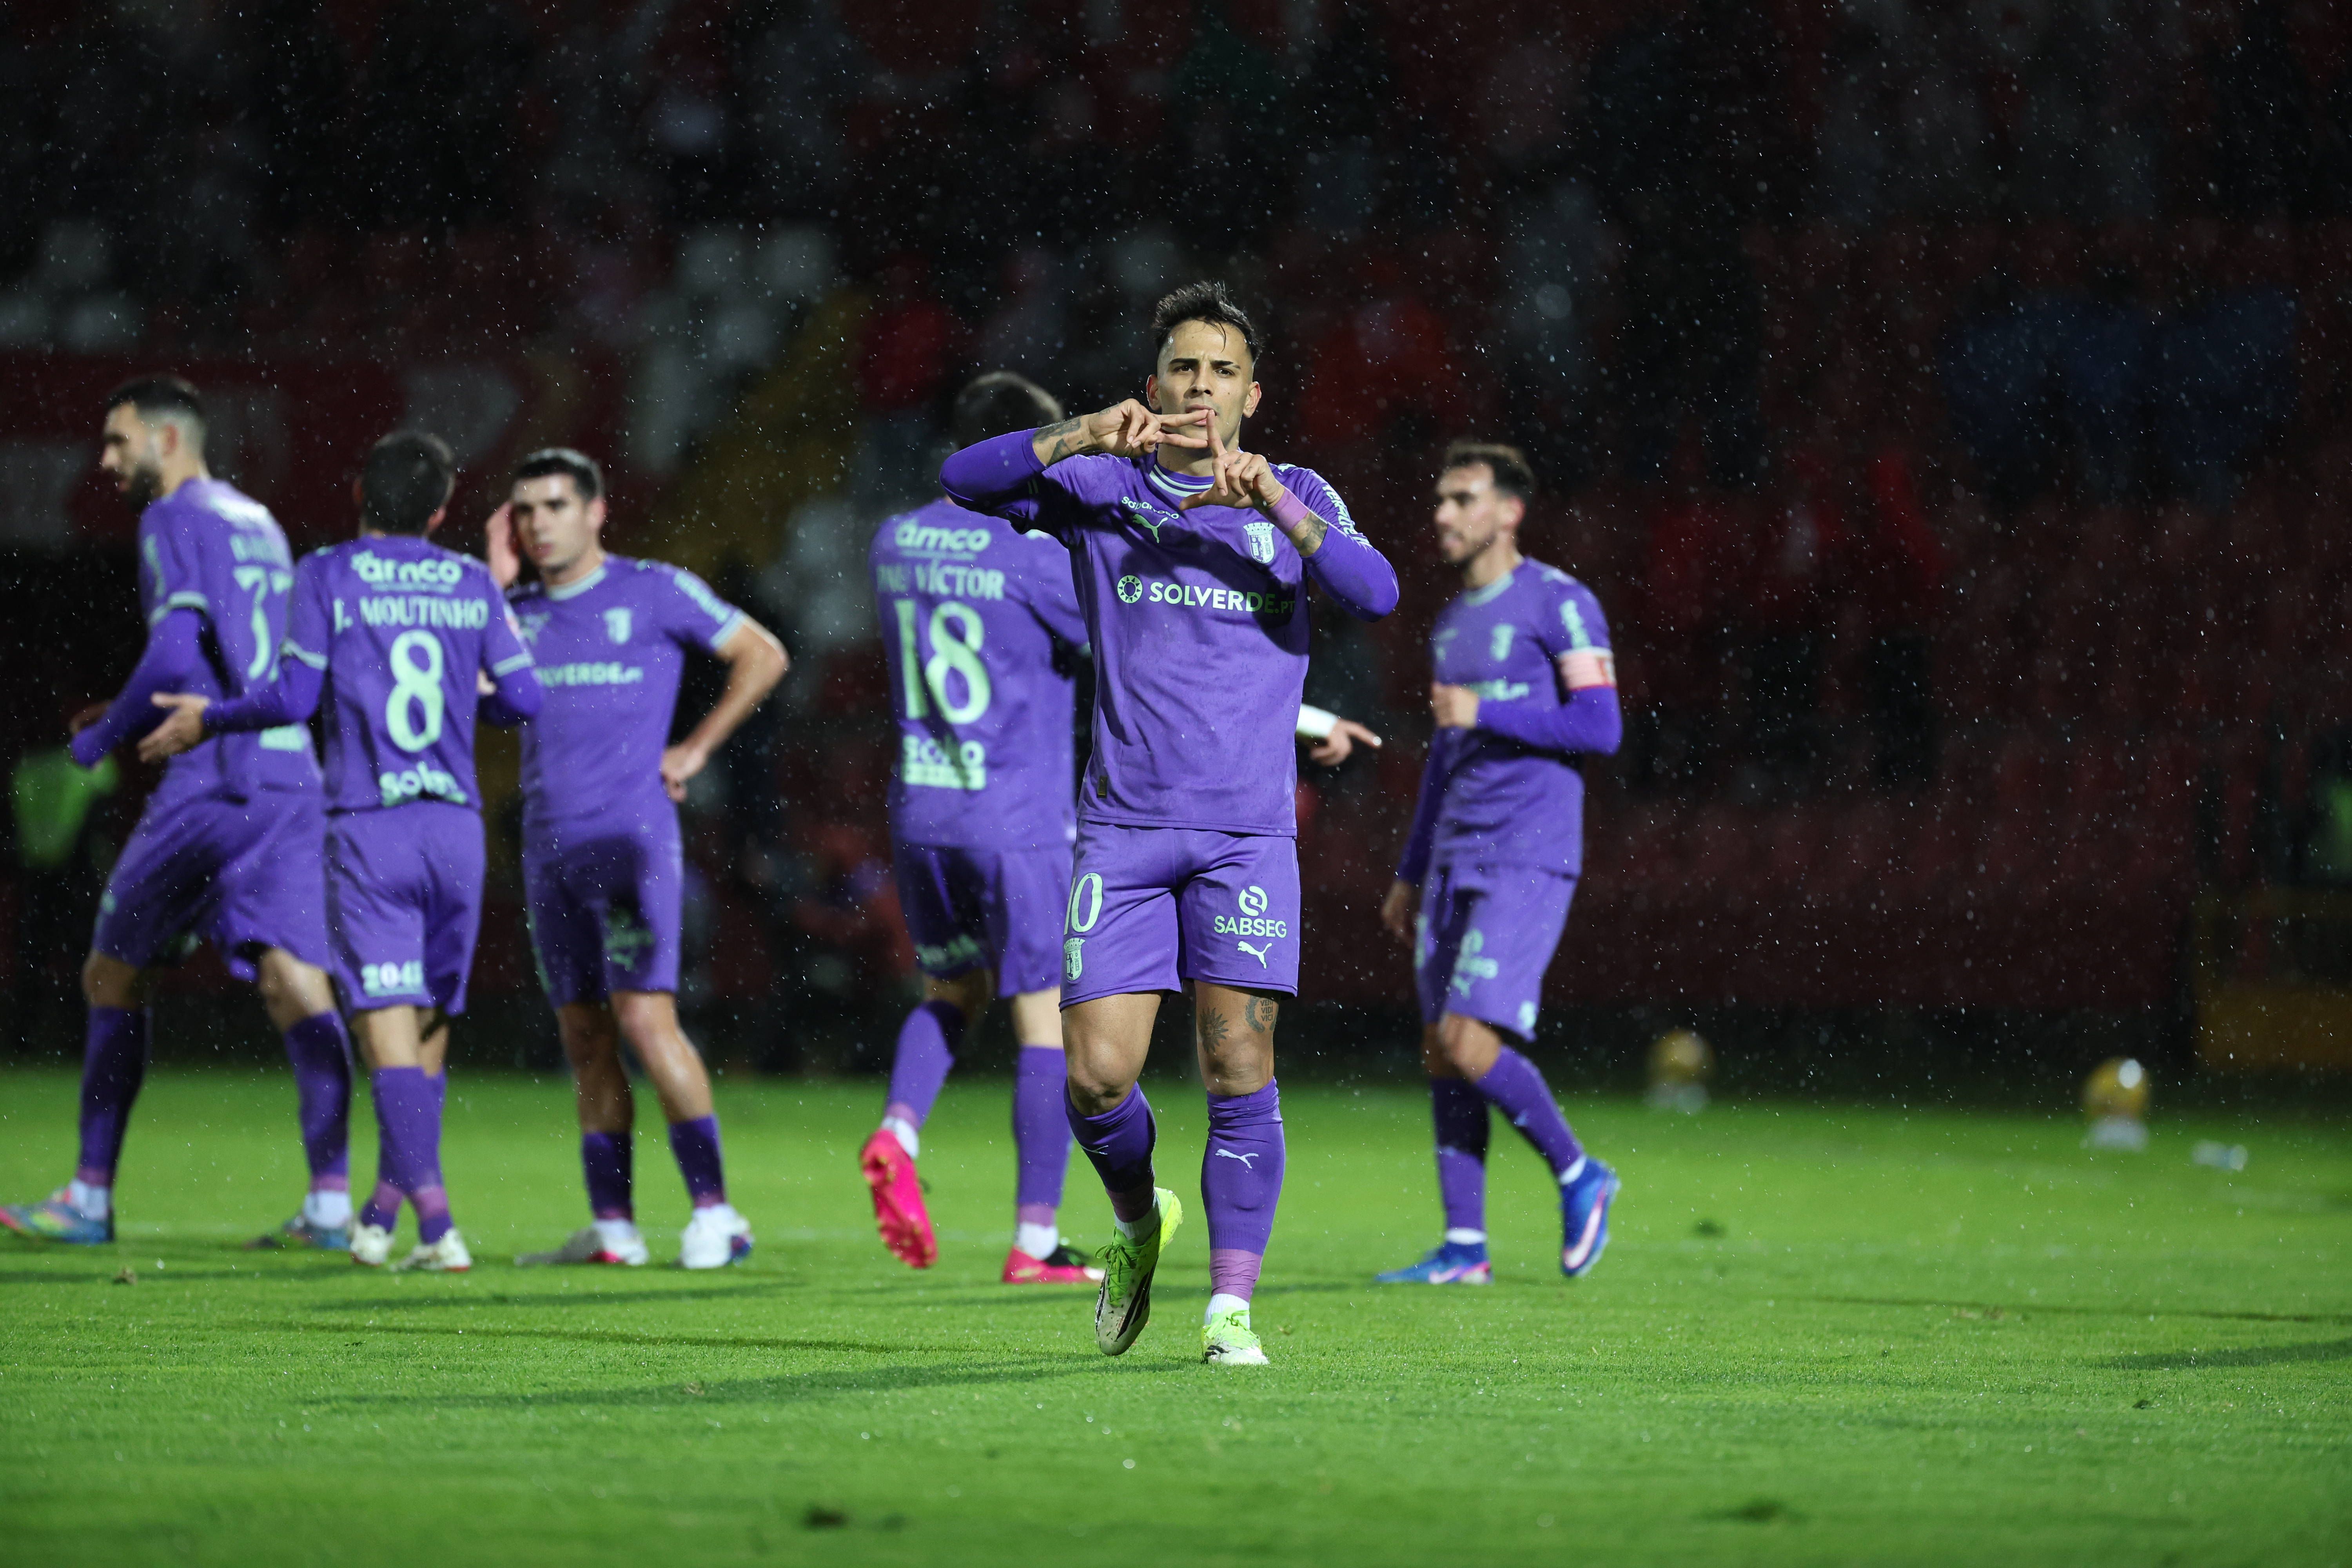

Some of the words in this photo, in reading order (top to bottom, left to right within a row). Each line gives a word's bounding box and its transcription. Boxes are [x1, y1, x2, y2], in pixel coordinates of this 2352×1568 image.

[359, 595, 489, 630] MOUTINHO
[1149, 582, 1296, 614] SOLVERDE.PT
[894, 599, 991, 724] 18
[386, 629, 445, 753] 8
[1214, 915, 1287, 938] SABSEG
